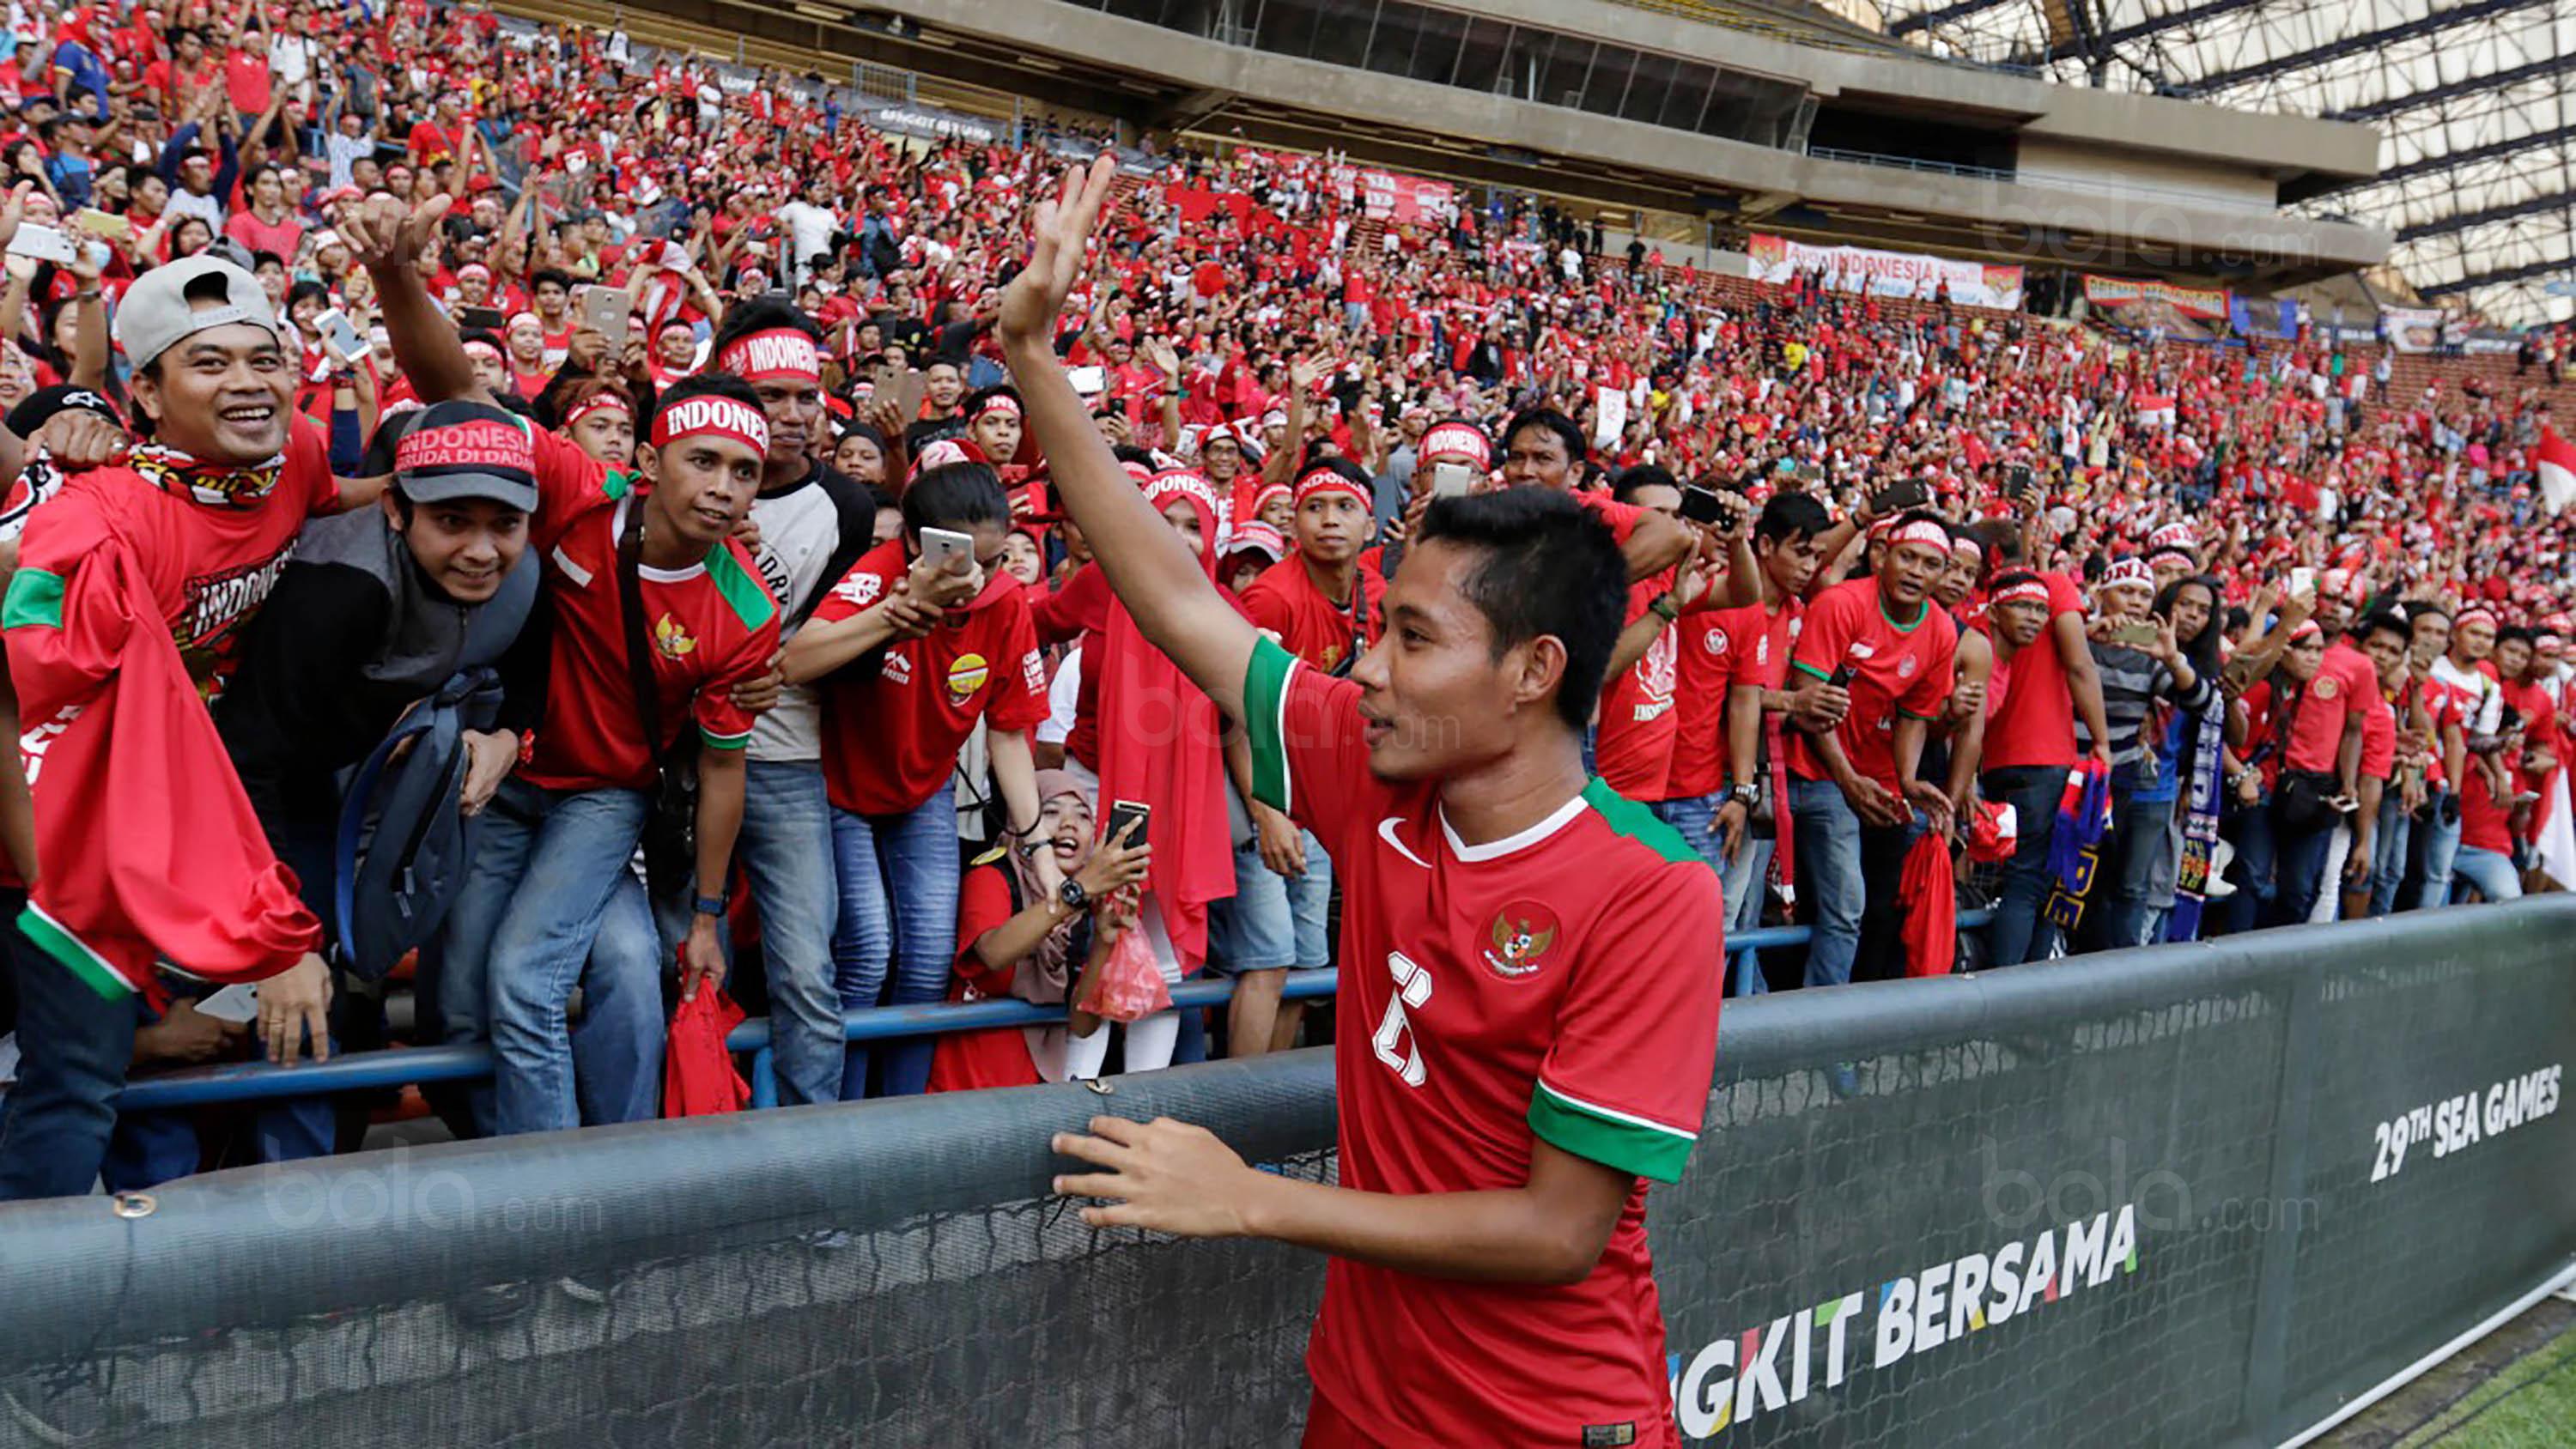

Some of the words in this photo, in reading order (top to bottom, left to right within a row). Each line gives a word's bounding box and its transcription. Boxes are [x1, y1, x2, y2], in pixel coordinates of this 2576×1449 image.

[1373, 951, 1432, 1088] 6
[2370, 1104, 2432, 1184] 29TH
[2433, 1091, 2481, 1159] SEA
[2484, 1063, 2563, 1137] GAMES
[1669, 1290, 1864, 1440] GKIT
[1874, 1203, 2138, 1370] BERSAMA
